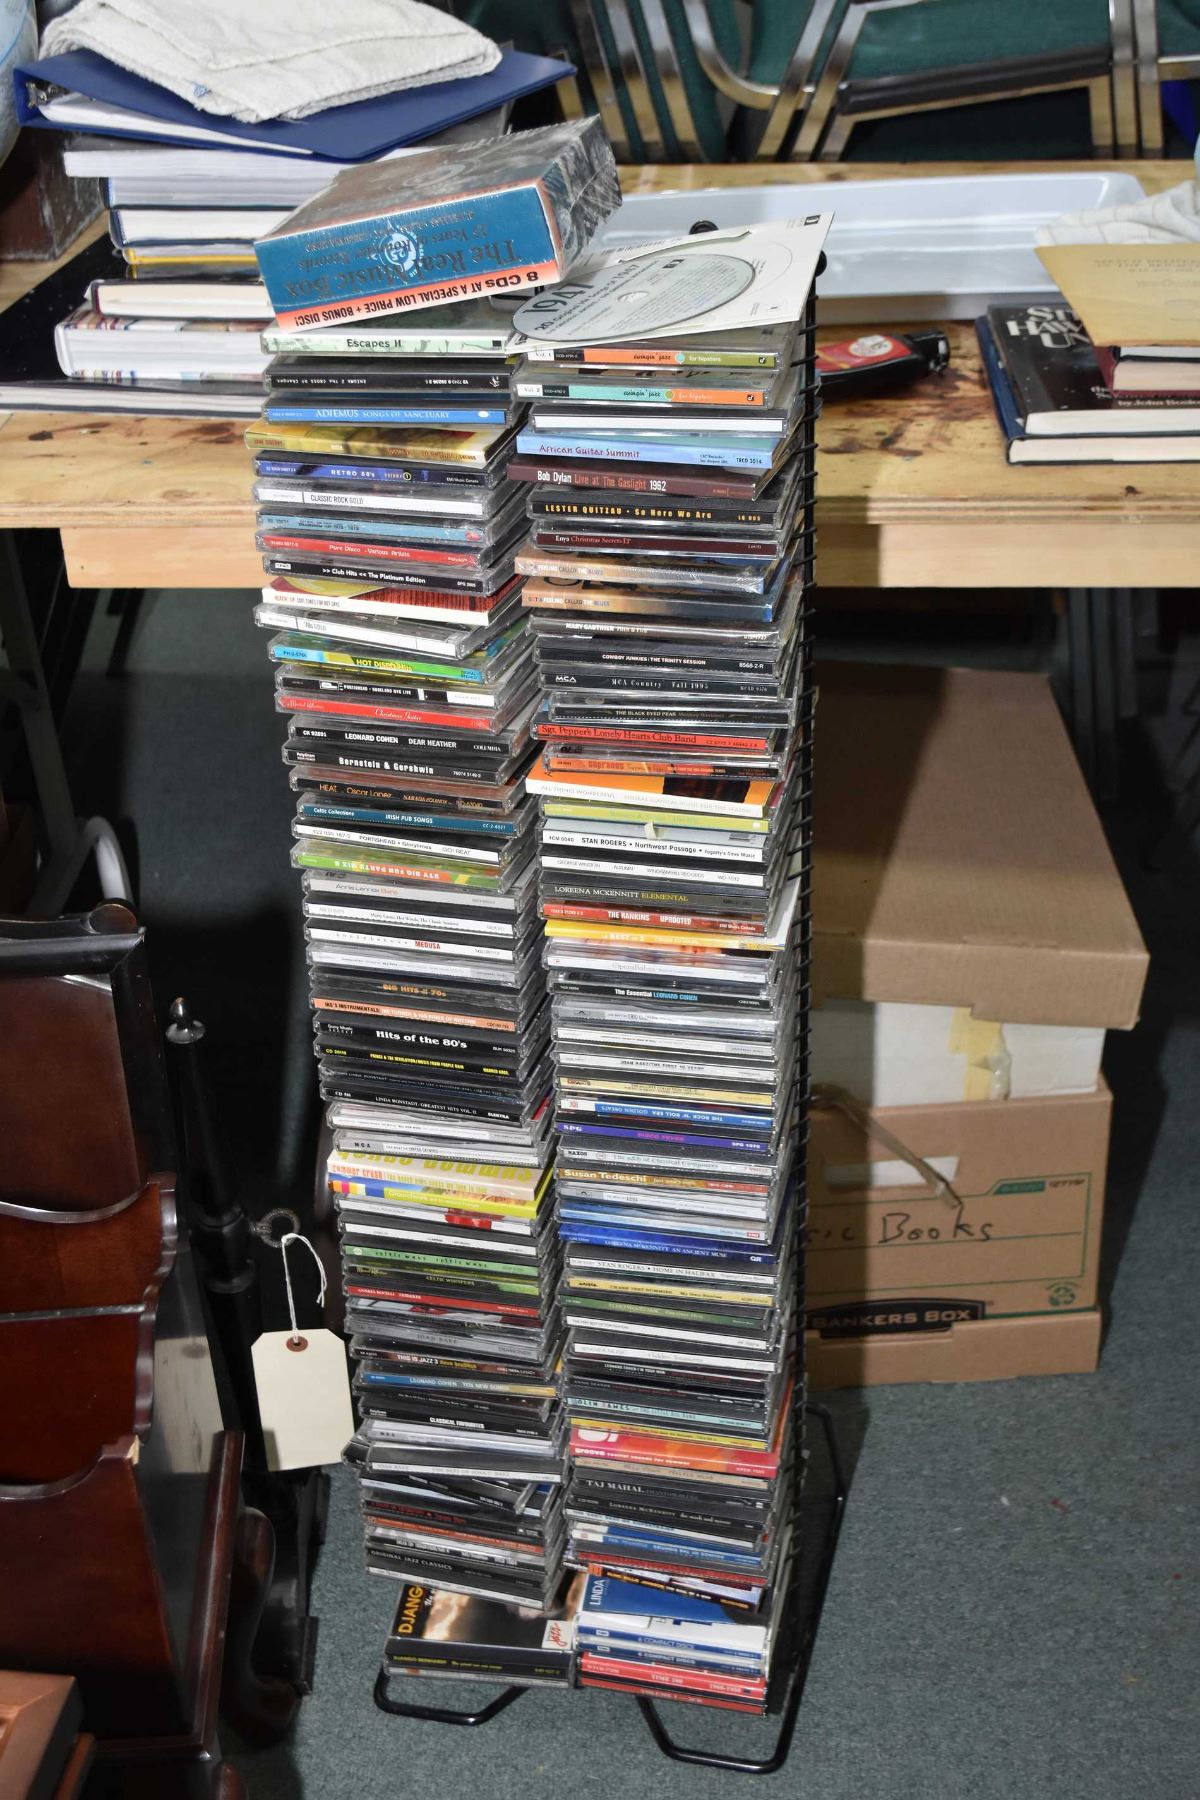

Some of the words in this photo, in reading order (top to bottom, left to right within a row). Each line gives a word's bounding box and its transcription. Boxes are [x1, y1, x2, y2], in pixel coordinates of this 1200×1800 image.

[469, 239, 521, 267] The
[485, 275, 521, 289] CDs
[527, 271, 538, 282] 8
[418, 286, 457, 302] SPECIAL
[460, 285, 467, 295] A
[470, 281, 481, 293] AT
[395, 294, 416, 306] LOW
[523, 283, 595, 313] 1947
[364, 299, 392, 313] PRICE
[294, 313, 319, 327] DISC!
[322, 306, 353, 321] BONUS
[347, 339, 390, 348] Escapes
[316, 409, 358, 417] ADIEMUS
[539, 444, 573, 454] African
[576, 445, 603, 456] Guitar
[606, 448, 640, 458] Summit
[538, 470, 550, 481] Bob
[553, 471, 572, 484] Dylan
[575, 474, 588, 484] Live
[591, 477, 598, 485] at
[603, 476, 615, 487] The
[618, 478, 646, 489] Gaslight
[650, 480, 666, 491] 1962
[545, 504, 578, 513] LESTER
[582, 505, 622, 515] QUITZAU
[650, 508, 672, 517] Here
[555, 535, 570, 543] Enya
[571, 536, 600, 544] Christmas
[602, 537, 622, 545] Secrets
[379, 574, 404, 582] Platinum
[406, 576, 425, 584] Edition
[612, 678, 627, 686] MCA
[631, 680, 662, 688] Country
[345, 733, 374, 742] LEONARD
[376, 735, 398, 743] COHEN
[542, 725, 557, 735] Sgt.
[559, 726, 592, 737] Pepper's
[594, 728, 621, 740] Lonely
[623, 731, 651, 741] Hearts
[652, 732, 669, 742] Club
[673, 734, 697, 744] Band
[409, 738, 425, 746] DEAR
[428, 740, 456, 748] HEATHER
[339, 757, 381, 769] Bernstein
[384, 761, 390, 769] &
[393, 762, 434, 774] Gershwin
[320, 784, 337, 792] HEAT
[359, 835, 396, 845] PORTISHEAD
[581, 837, 598, 845] STAN
[600, 839, 627, 847] ROGERS
[635, 841, 668, 851] Northwest
[669, 844, 697, 854] Passage
[555, 886, 591, 896] LOREENA
[593, 888, 639, 899] MCKENNITT
[641, 892, 689, 902] ELEMENTAL
[608, 911, 620, 919] THE
[621, 911, 650, 922] RANKINS
[660, 915, 692, 925] UPROOTED
[415, 940, 441, 950] MEDUSA
[383, 984, 398, 992] BIG
[400, 986, 418, 994] HITS
[615, 988, 625, 996] The
[626, 989, 652, 997] Essential
[376, 1030, 400, 1040] Hits
[404, 1033, 417, 1042] of
[419, 1036, 440, 1046] the
[442, 1038, 467, 1049] 80's
[564, 1169, 597, 1179] Susan
[600, 1172, 646, 1183] Tedeschi
[878, 1200, 994, 1244] Books
[598, 1261, 617, 1269] STAN
[812, 1312, 918, 1328] BANKERS
[925, 1309, 970, 1322] BOX
[586, 1480, 605, 1488] TAJ
[607, 1482, 645, 1493] MAHAL
[371, 1550, 402, 1562] ORIGINAL
[404, 1556, 420, 1565] JAZZ
[422, 1559, 452, 1570] CLASSICS
[590, 1579, 605, 1606] LINDA
[398, 1585, 424, 1634] DJANG
